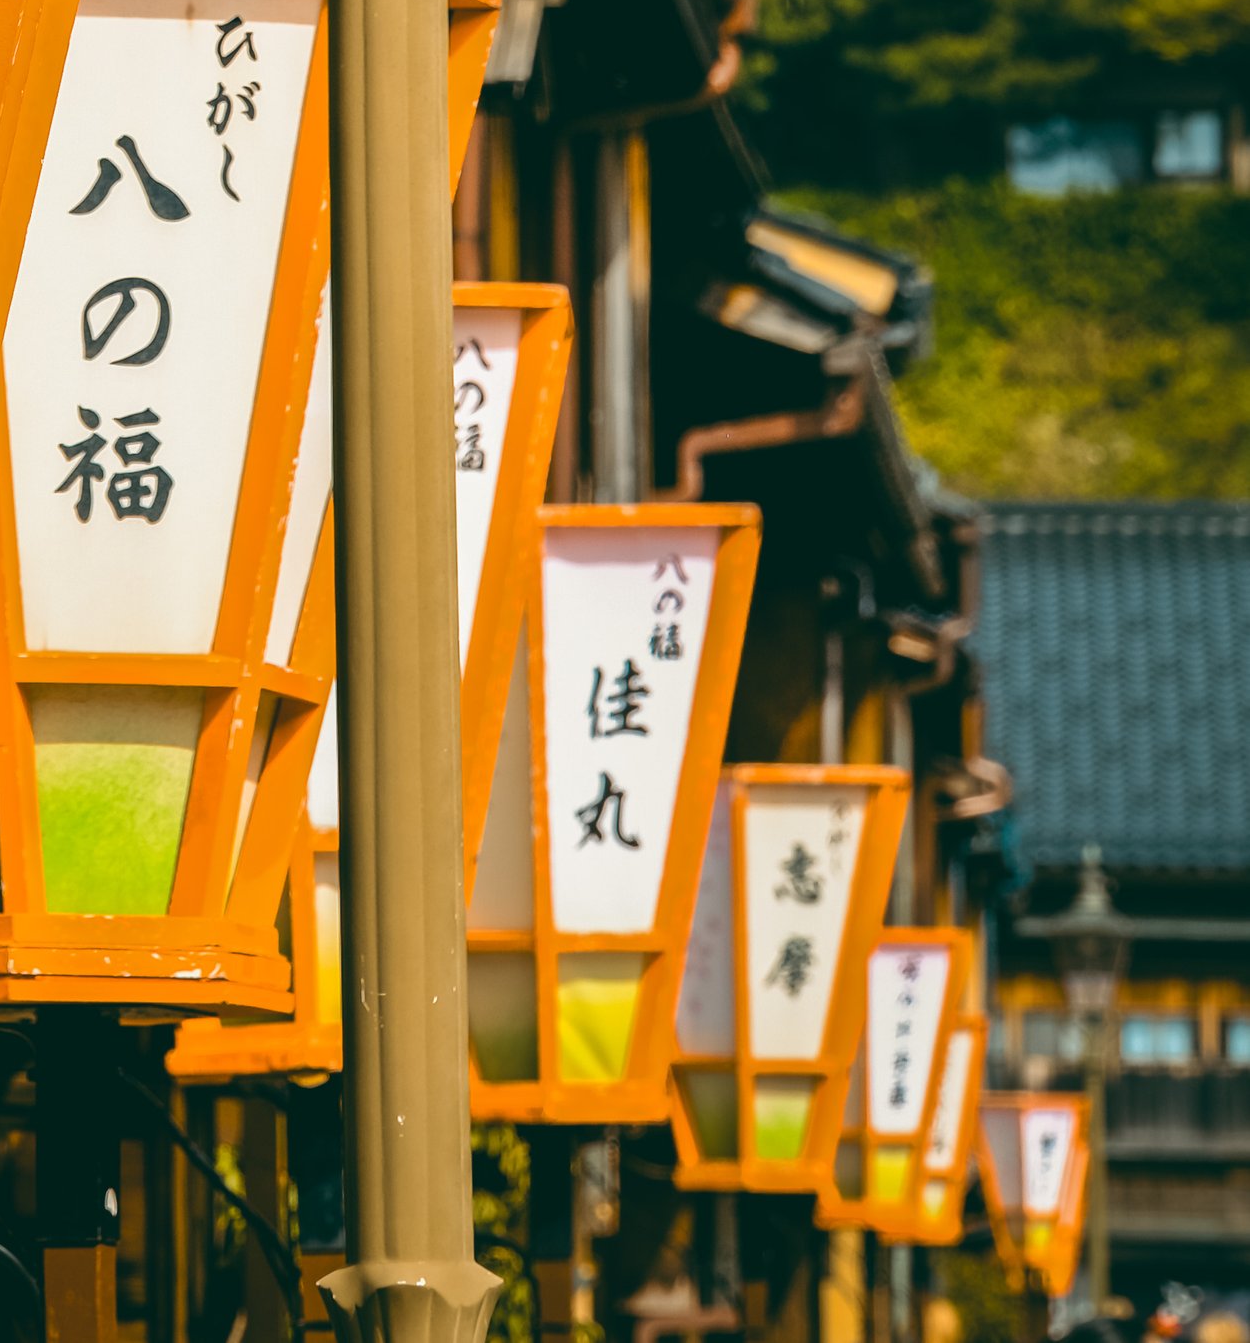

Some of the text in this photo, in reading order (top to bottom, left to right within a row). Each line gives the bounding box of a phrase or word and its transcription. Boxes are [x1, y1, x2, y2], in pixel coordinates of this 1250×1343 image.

[206, 16, 261, 202] ひがし
[54, 134, 191, 524] 八の福
[650, 552, 688, 660] 八の福
[574, 658, 651, 851] 佳丸
